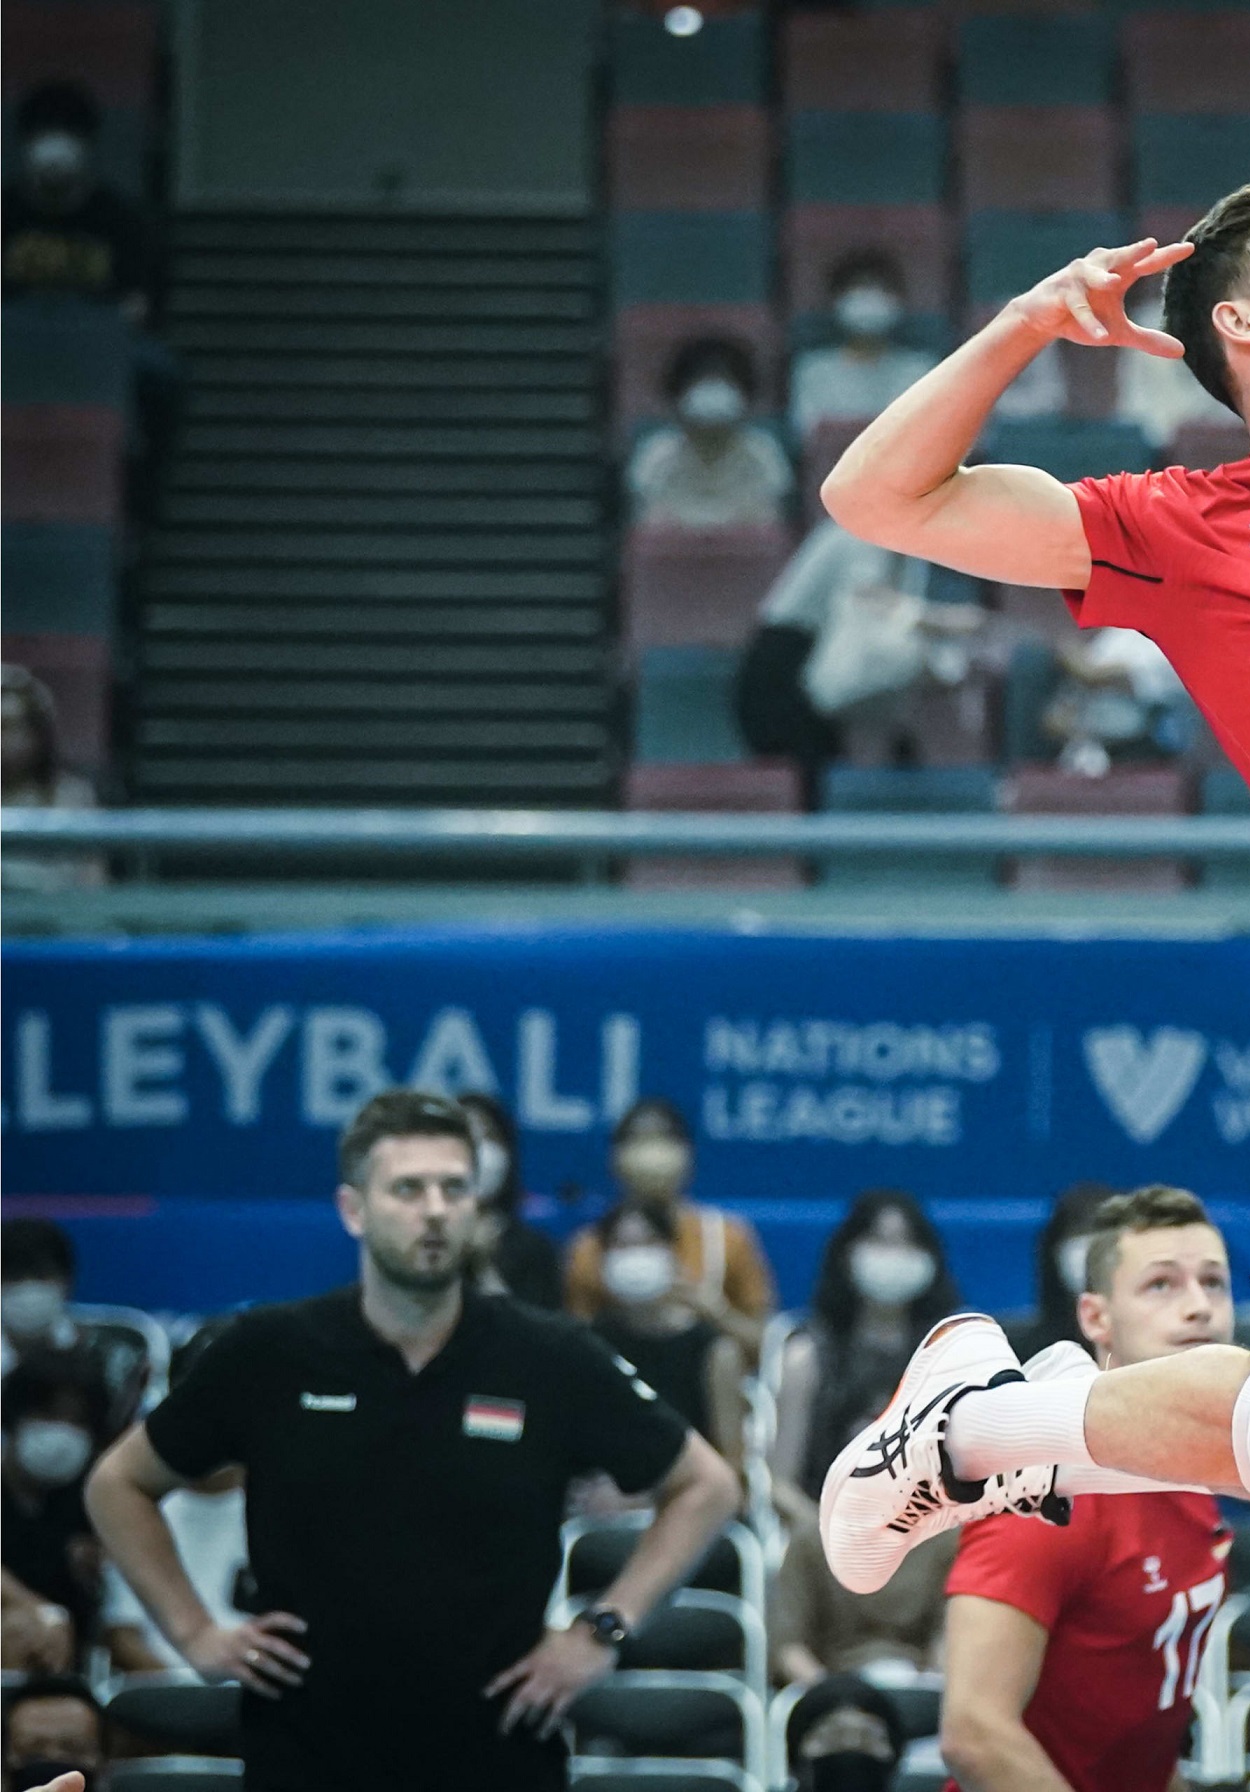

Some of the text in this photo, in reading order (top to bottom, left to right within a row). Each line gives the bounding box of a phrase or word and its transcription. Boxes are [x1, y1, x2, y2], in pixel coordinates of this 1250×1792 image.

[705, 1018, 996, 1080] NATIONS
[703, 1086, 961, 1143] LEAGUE
[1153, 1571, 1225, 1711] 17
